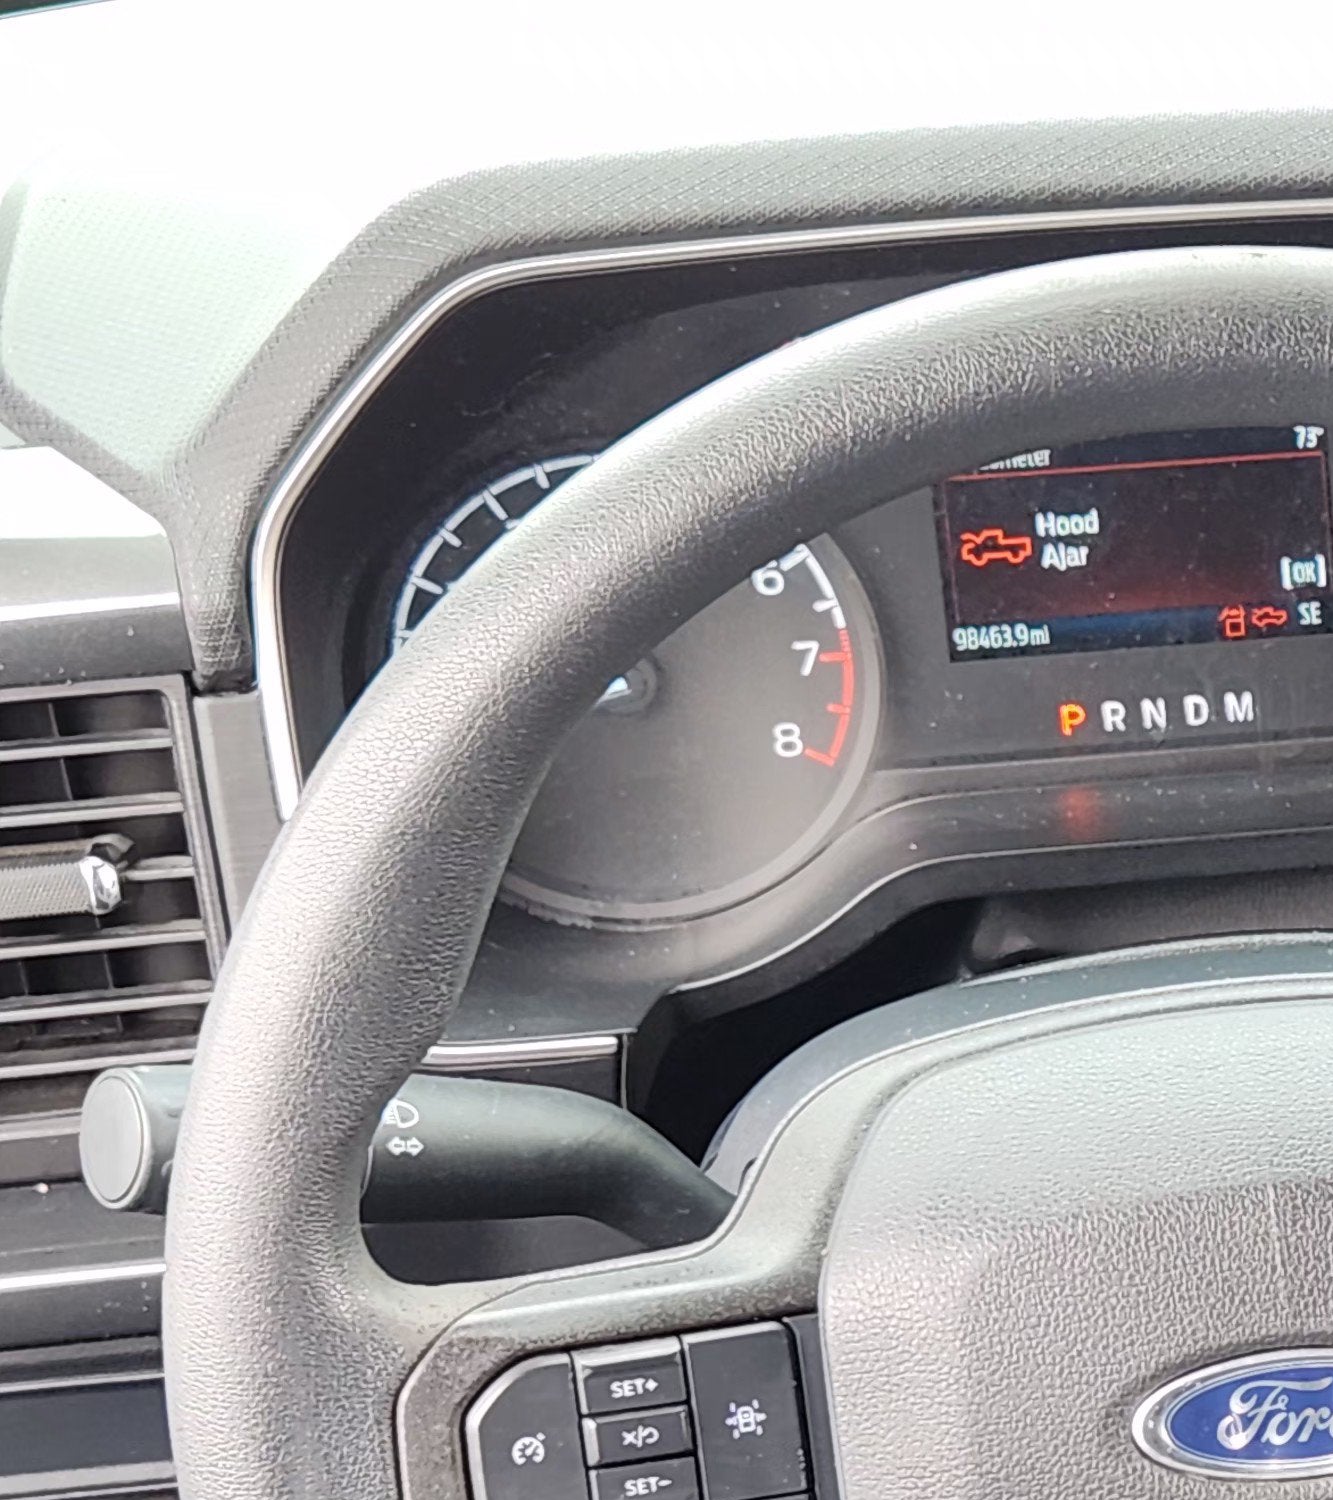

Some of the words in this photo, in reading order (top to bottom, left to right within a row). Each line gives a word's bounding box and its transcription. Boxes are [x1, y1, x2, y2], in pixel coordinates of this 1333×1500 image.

[1035, 508, 1099, 537] Hood
[1040, 542, 1089, 571] Ajar
[750, 559, 785, 595] 6
[1297, 602, 1322, 626] SE
[791, 640, 820, 676] 7
[1058, 704, 1086, 736] P
[1100, 700, 1127, 732] R
[1140, 697, 1168, 730] N
[1183, 694, 1210, 727] D
[1223, 691, 1255, 724] M
[772, 722, 803, 757] 8
